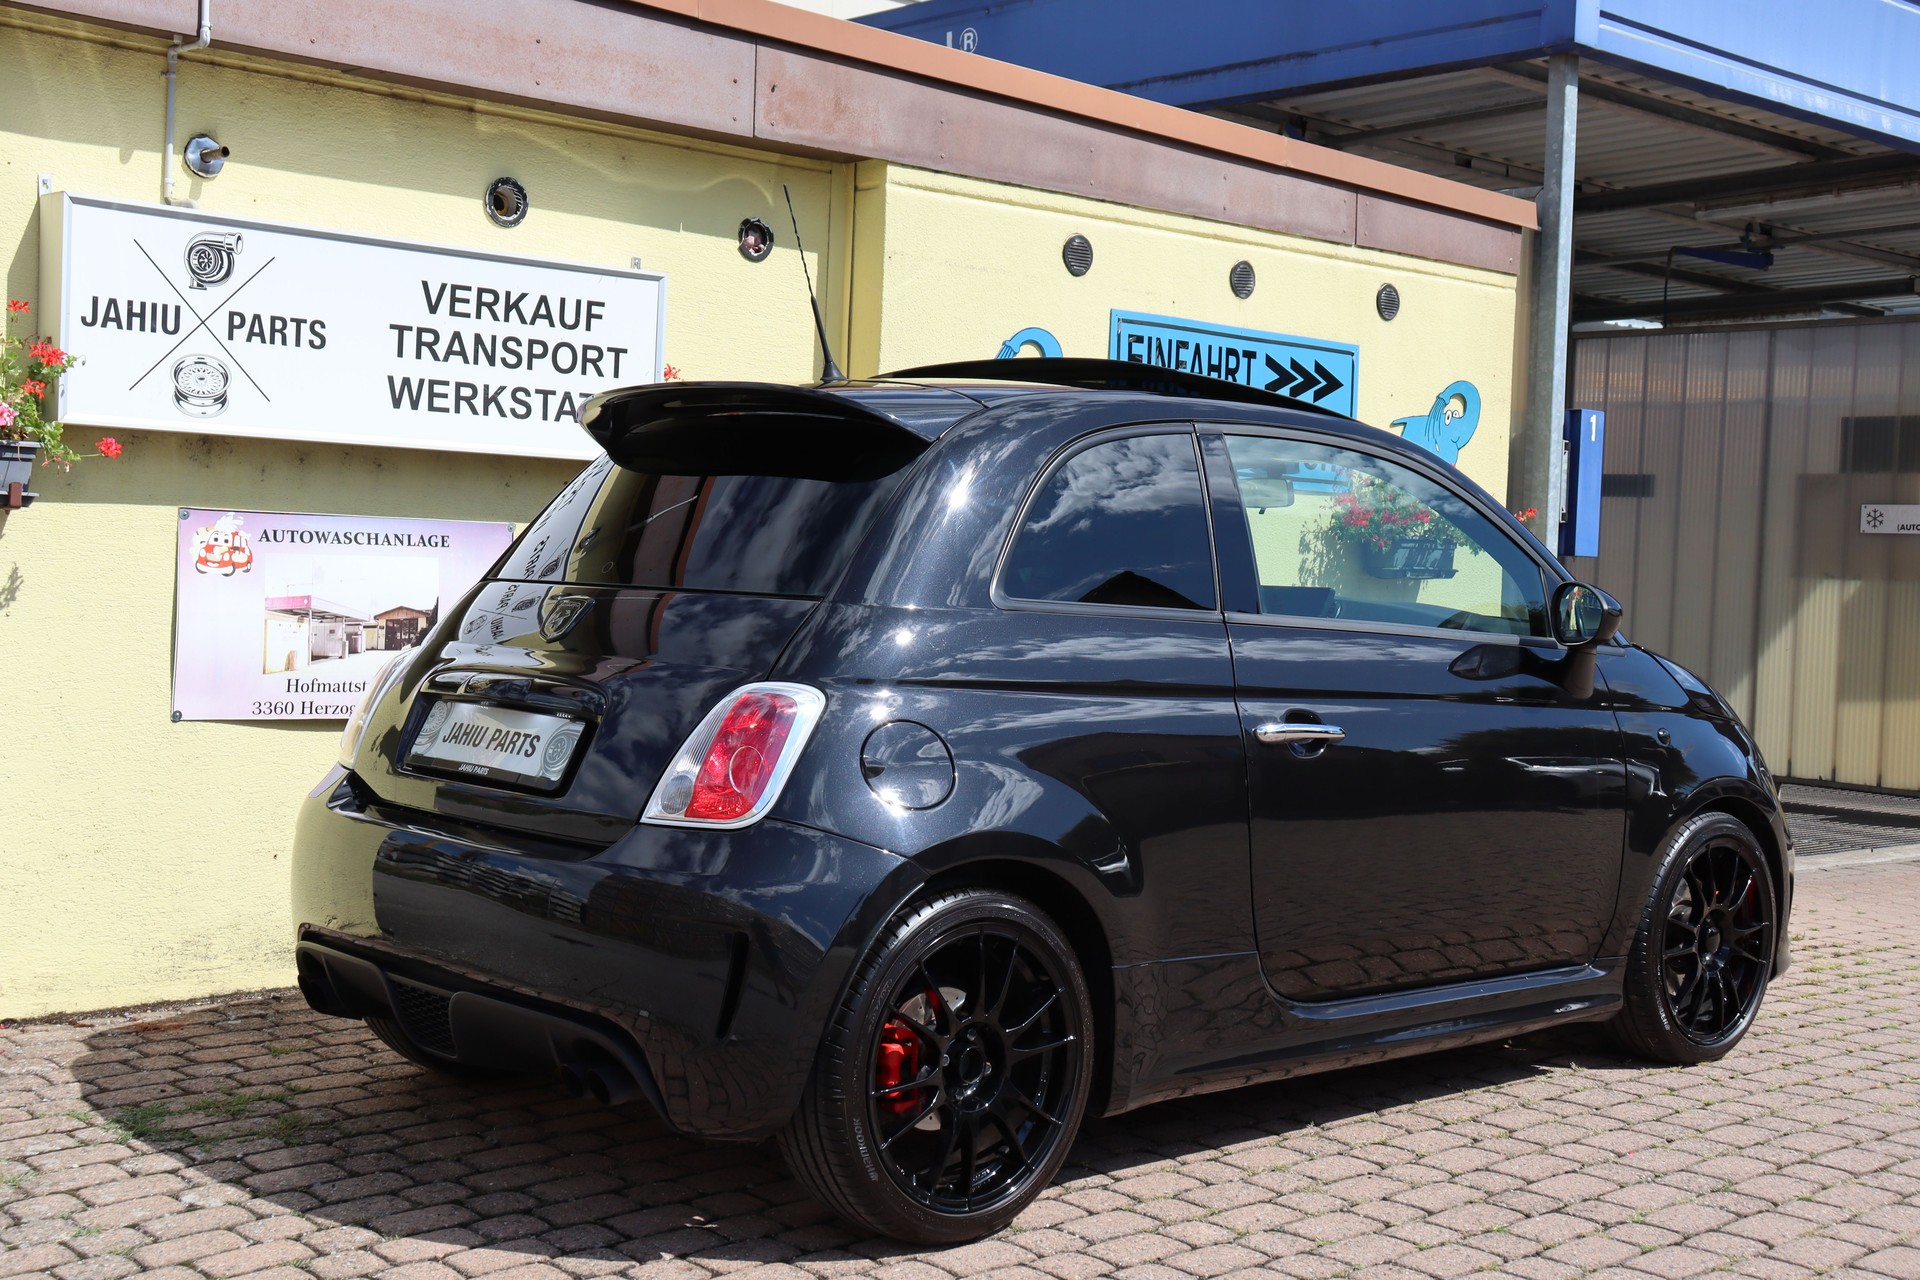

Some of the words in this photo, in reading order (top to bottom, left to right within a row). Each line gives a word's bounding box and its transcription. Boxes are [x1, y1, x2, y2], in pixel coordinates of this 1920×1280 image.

[81, 295, 181, 335] JAHIU
[227, 310, 327, 350] PARTS
[421, 280, 606, 332] VERKAUF
[389, 323, 628, 379] TRANSPORT
[1127, 333, 1257, 386] EINFAHRT
[386, 374, 594, 424] WERKSTA
[1590, 414, 1597, 442] 1
[258, 528, 450, 549] AUTOWASCHANLAGE
[252, 701, 295, 715] 3360
[442, 722, 490, 748] JAHIU
[485, 728, 541, 758] PARTS
